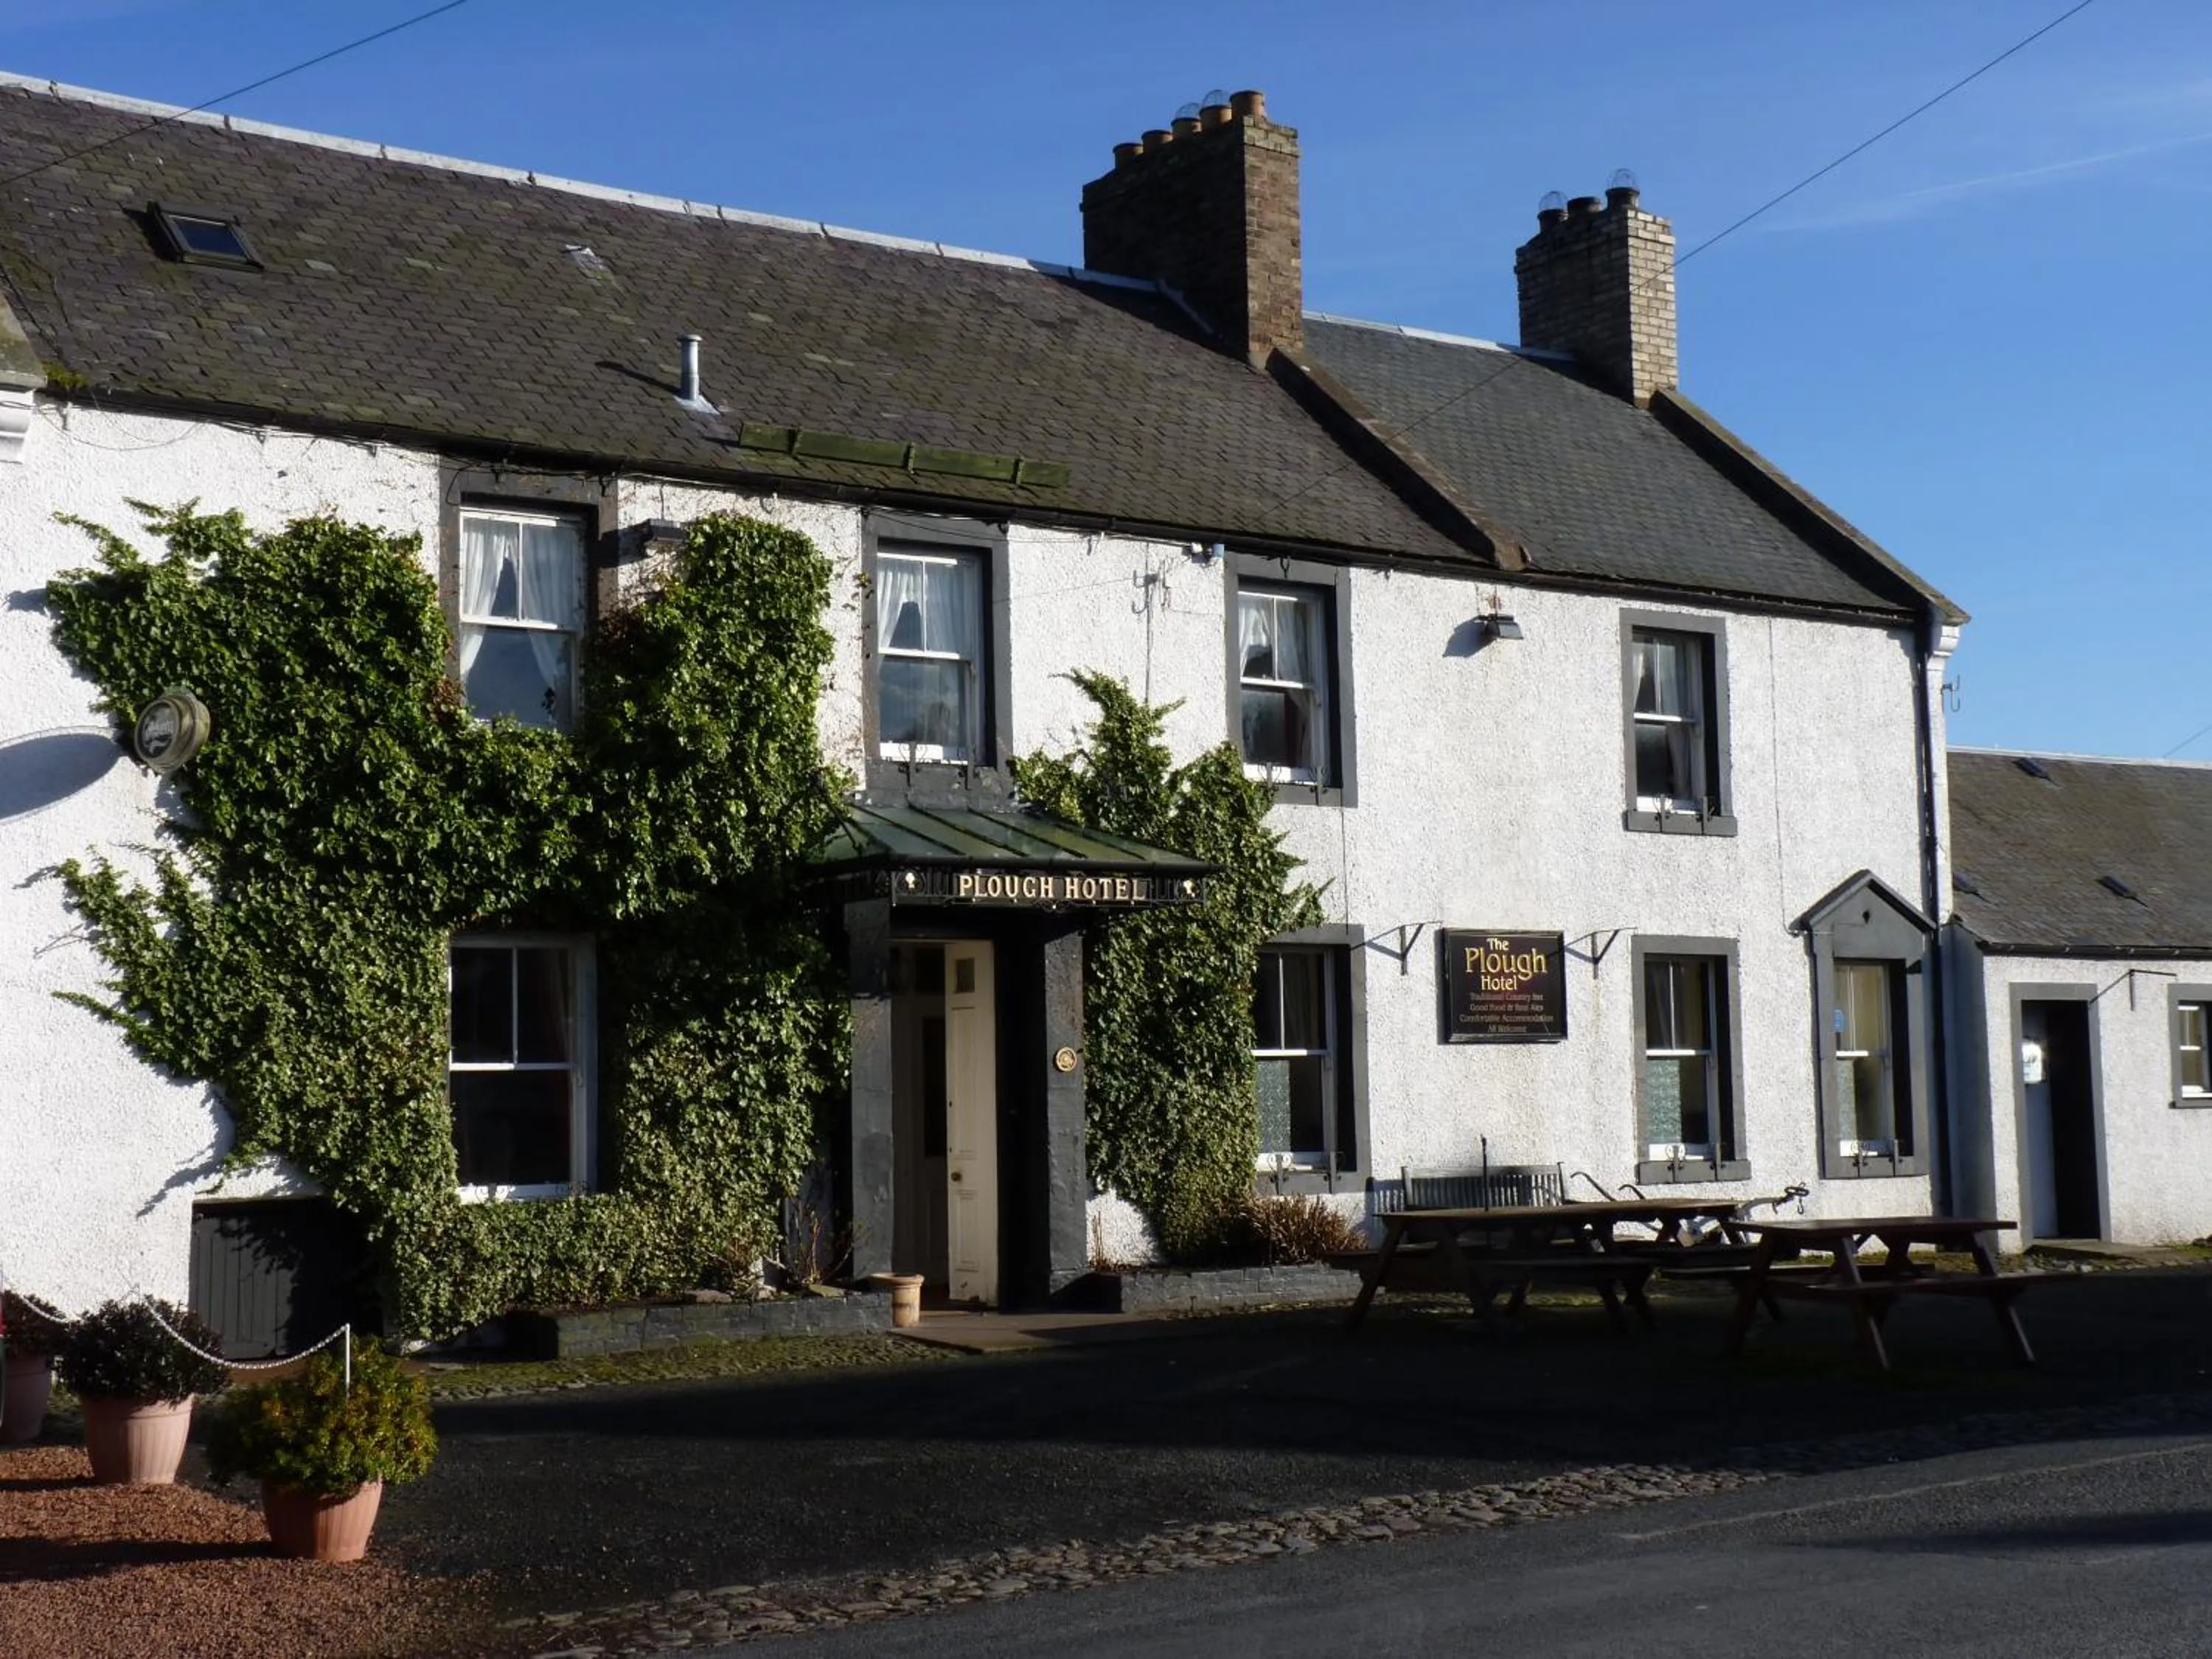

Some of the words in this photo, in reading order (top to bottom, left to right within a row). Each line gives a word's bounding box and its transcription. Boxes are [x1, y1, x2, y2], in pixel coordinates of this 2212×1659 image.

[959, 875, 1054, 898] PLOUGH
[1065, 877, 1146, 900] HOTEL
[1486, 937, 1509, 950] The
[1464, 947, 1548, 981] Plough
[1481, 974, 1517, 990] Hotel
